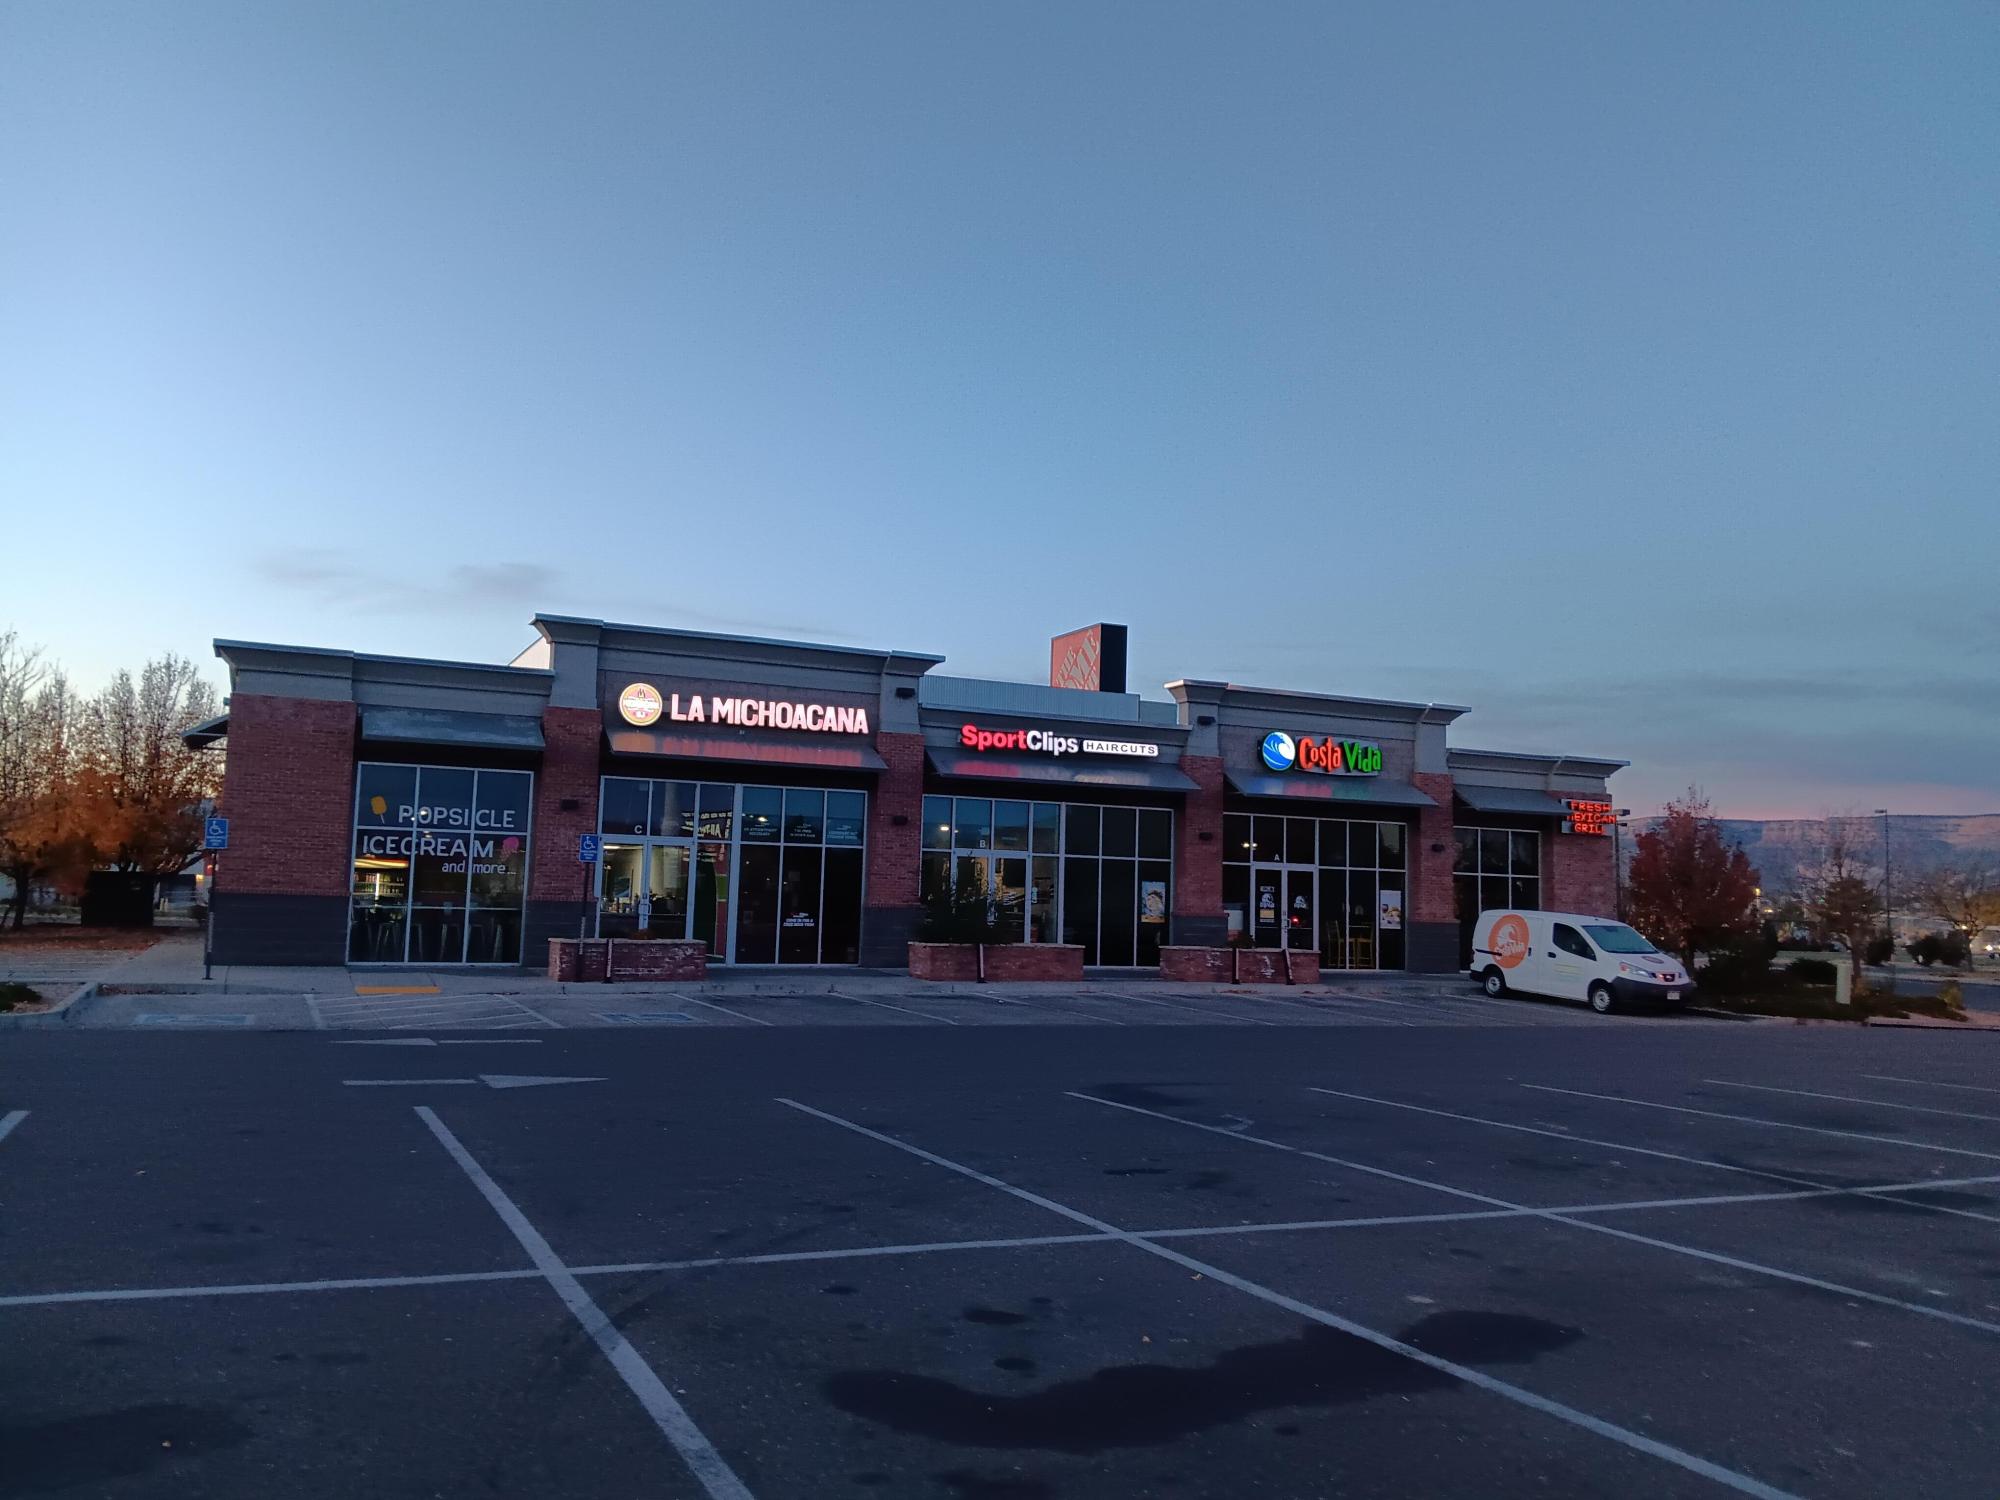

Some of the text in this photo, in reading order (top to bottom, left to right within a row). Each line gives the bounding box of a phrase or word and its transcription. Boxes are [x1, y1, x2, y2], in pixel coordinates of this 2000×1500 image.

[671, 694, 869, 734] LA MICHOACANA
[1086, 742, 1156, 754] HAIRCUTS
[1299, 736, 1382, 773] Costa Vida
[1571, 799, 1612, 812] FRESH
[398, 804, 516, 828] POPSICLE
[634, 824, 643, 834] C
[441, 860, 466, 873] and
